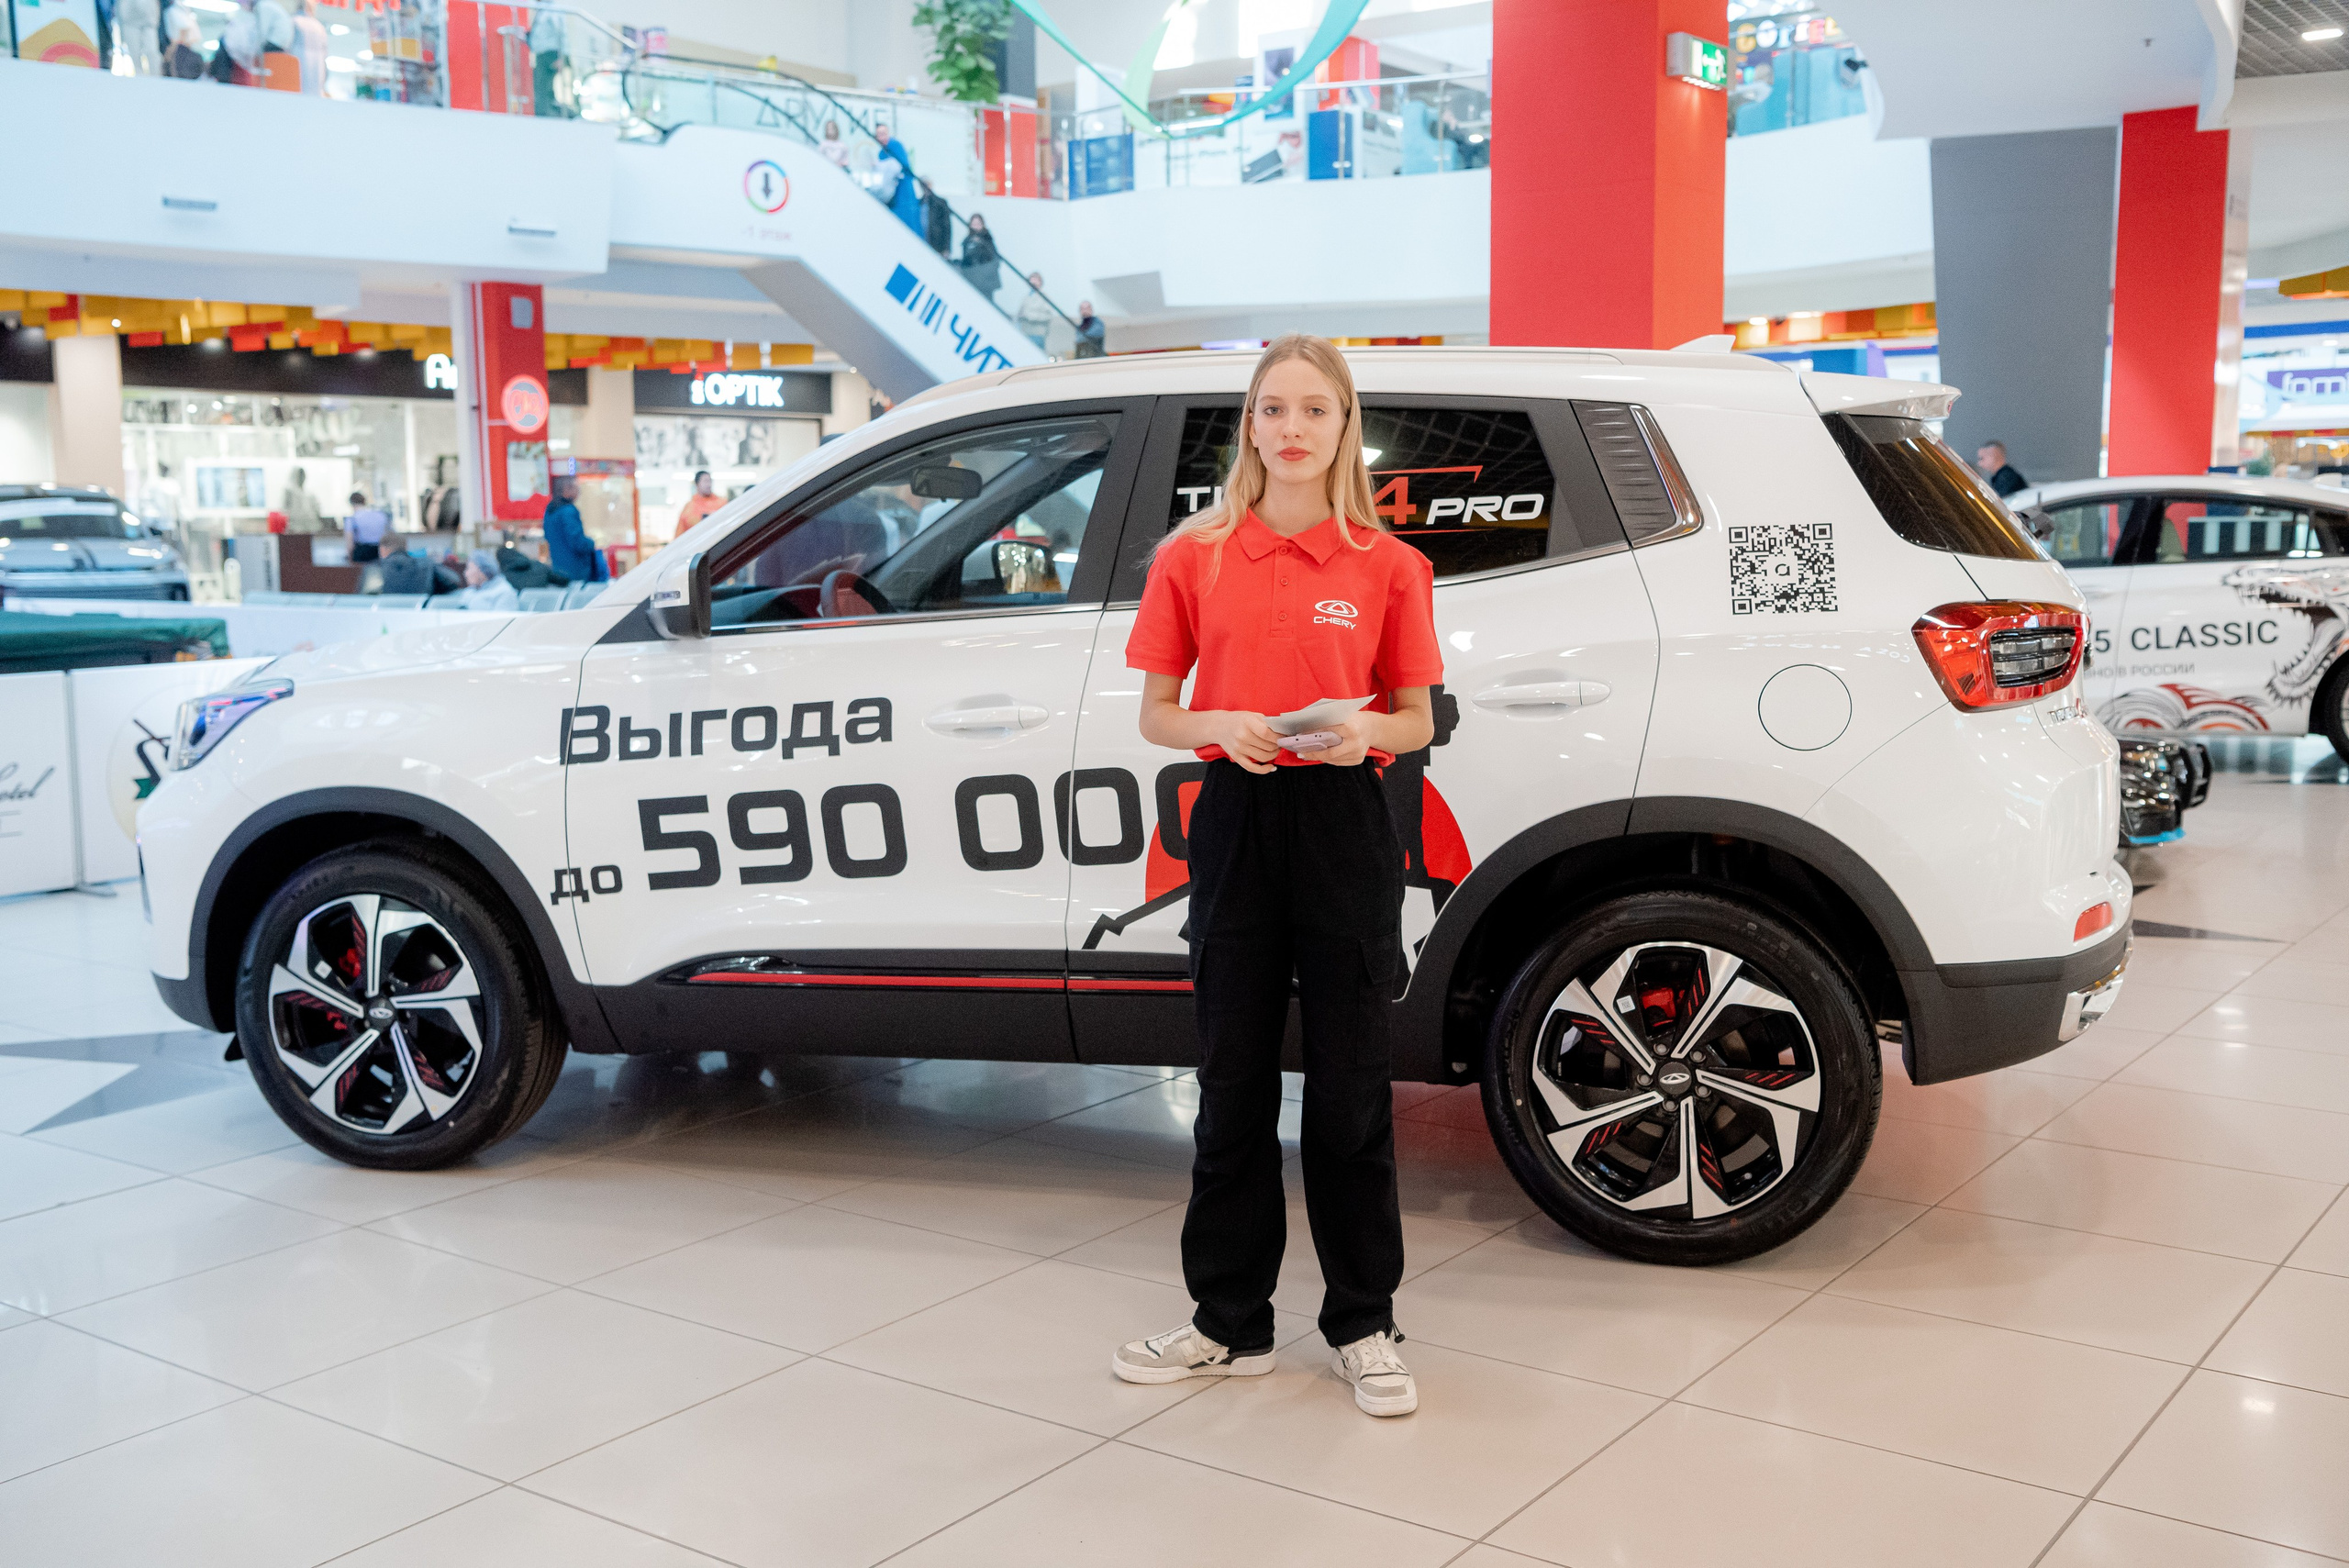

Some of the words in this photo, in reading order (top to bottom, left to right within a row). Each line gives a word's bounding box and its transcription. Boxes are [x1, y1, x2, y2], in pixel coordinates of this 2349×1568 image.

[1425, 493, 1544, 526] PRO
[1313, 616, 1356, 630] CHERY
[2131, 620, 2279, 651] CLASSIC
[559, 696, 894, 766] Выгода
[551, 864, 623, 906] до
[637, 783, 908, 892] 590
